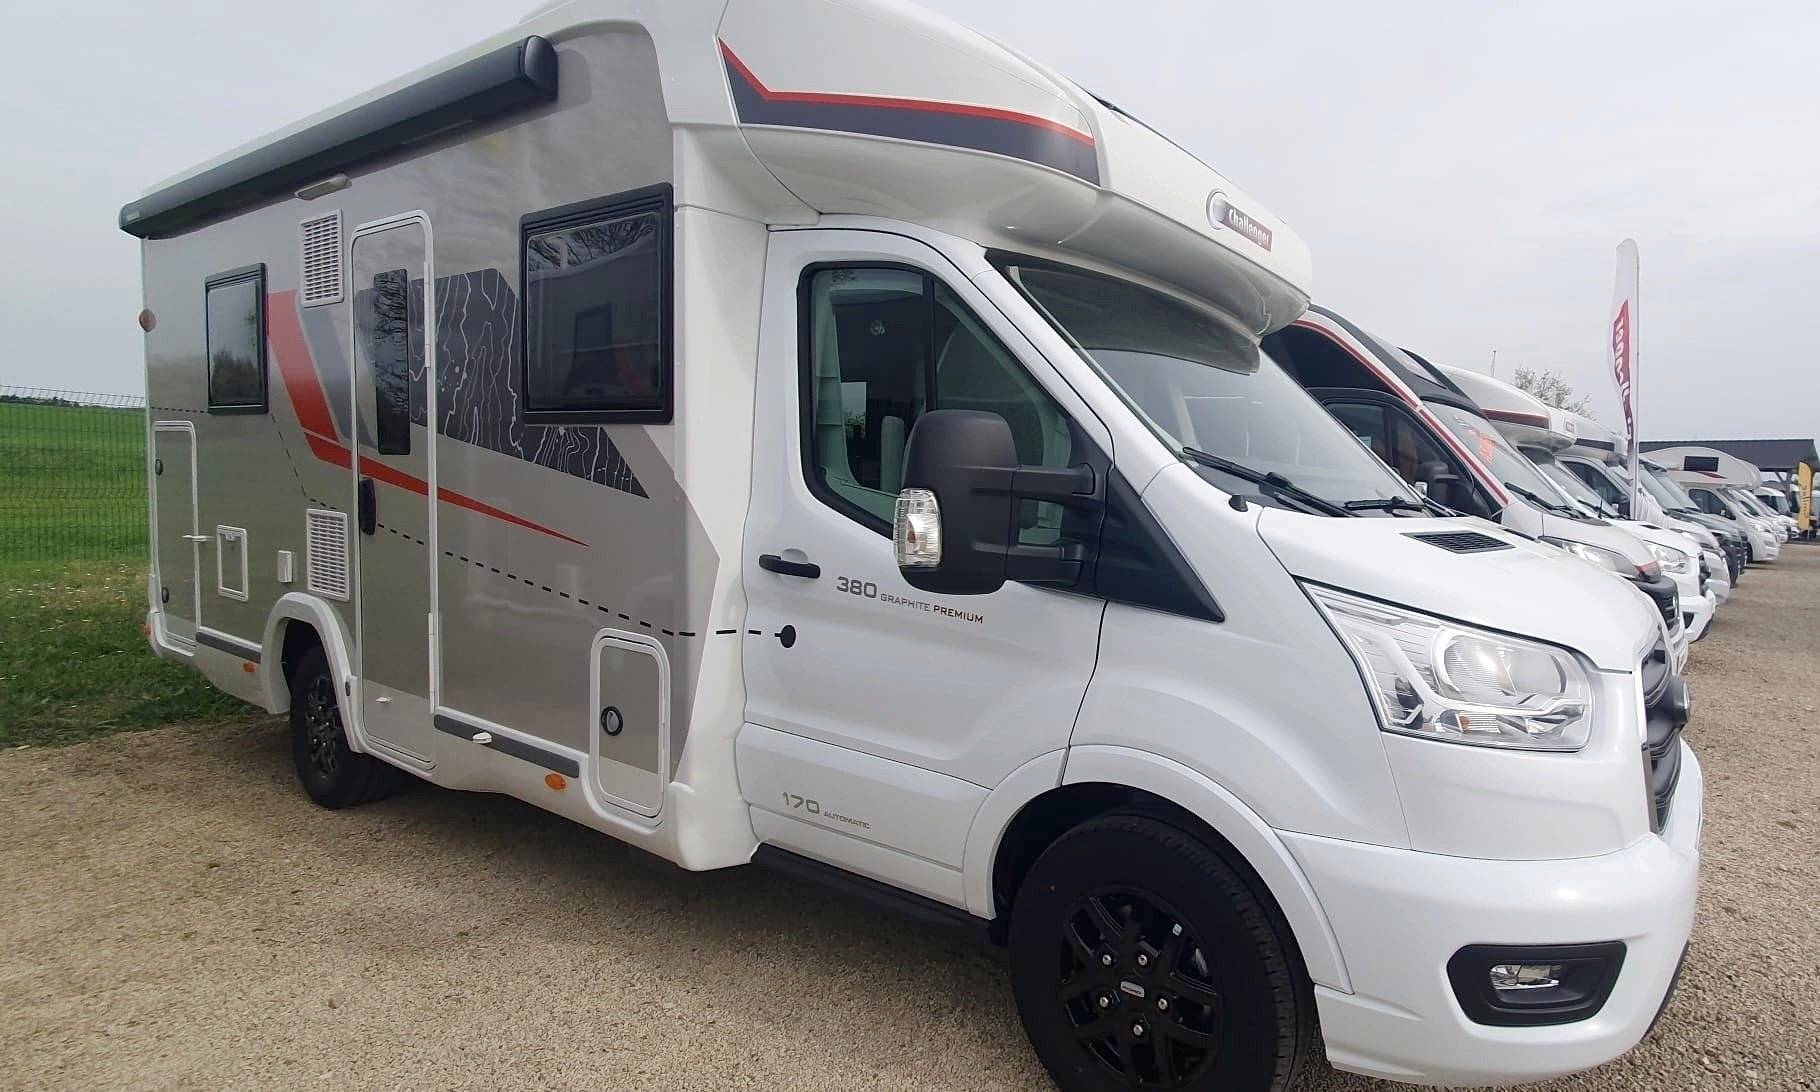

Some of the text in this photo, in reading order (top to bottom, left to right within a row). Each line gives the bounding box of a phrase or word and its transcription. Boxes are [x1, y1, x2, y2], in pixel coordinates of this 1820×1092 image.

[1228, 207, 1271, 248] Challenger
[836, 575, 984, 624] 380 GRAPHITE PREMIUM
[782, 791, 871, 830] 170 AUTOMATIC
